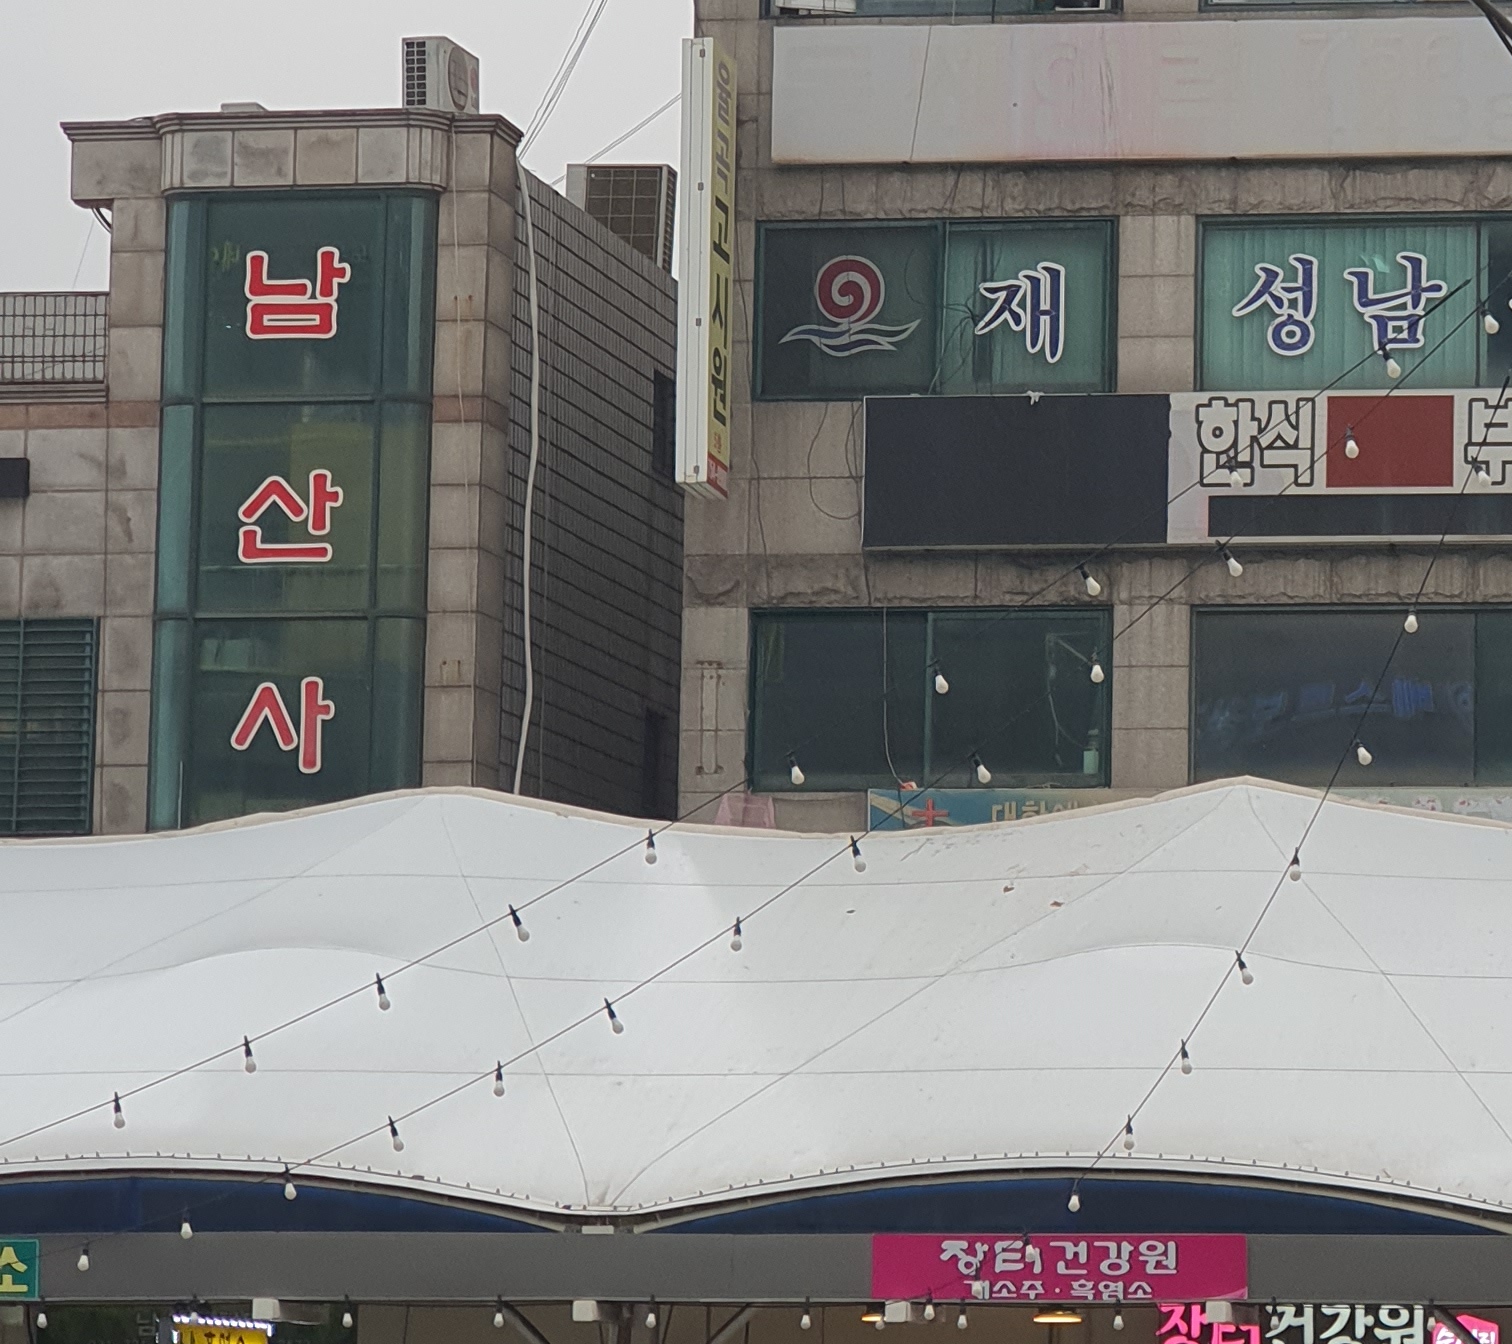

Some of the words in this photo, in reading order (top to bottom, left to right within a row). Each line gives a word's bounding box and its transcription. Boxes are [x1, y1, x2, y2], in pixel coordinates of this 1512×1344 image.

[974, 261, 1066, 364] 재
[1231, 251, 1449, 356] 성남
[1195, 396, 1316, 488] 한식
[1070, 1279, 1153, 1301] 흑염소
